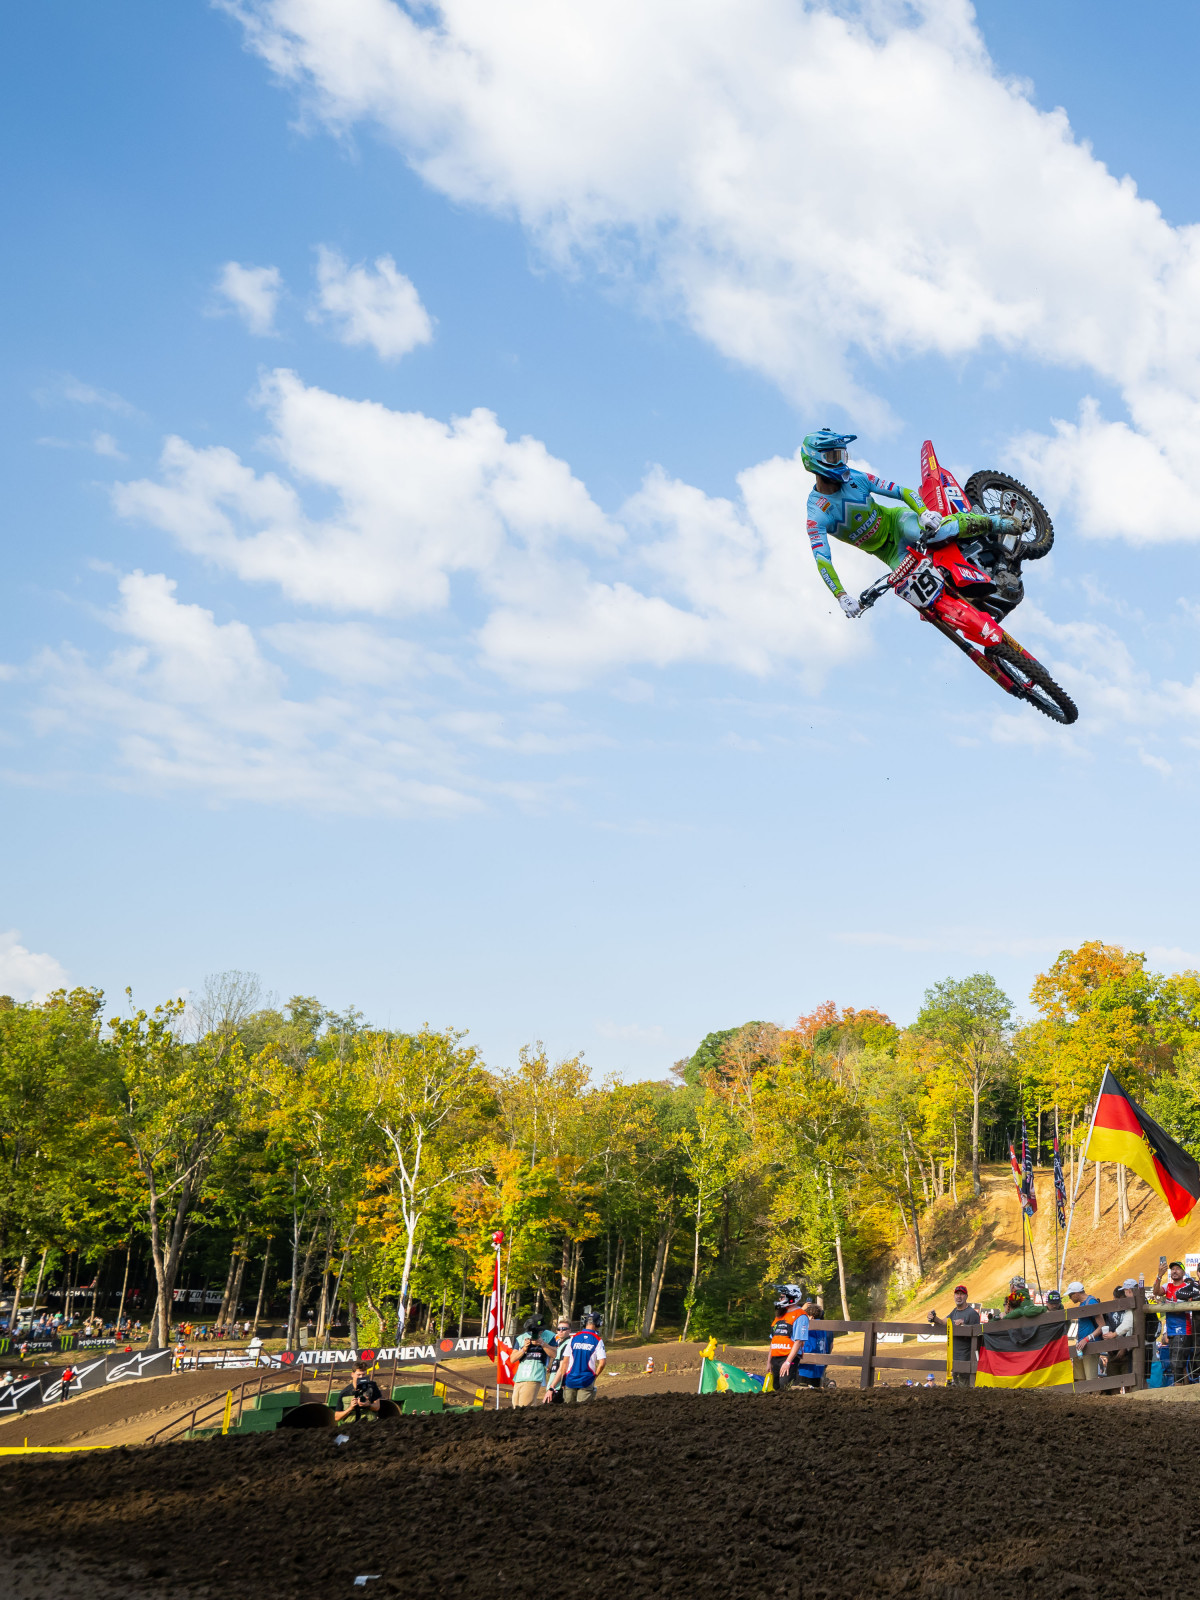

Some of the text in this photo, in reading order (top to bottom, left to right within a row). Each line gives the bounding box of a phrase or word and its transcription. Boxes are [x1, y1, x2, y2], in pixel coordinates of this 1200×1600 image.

[936, 485, 945, 510] HONDA
[849, 509, 877, 541] SLOVENIA
[855, 516, 882, 547] HONDA
[909, 569, 939, 604] 19
[14, 1341, 53, 1349] MNSTER
[78, 1338, 116, 1346] MONSTER
[455, 1336, 512, 1352] ATHA
[573, 1342, 595, 1351] FRANCE
[296, 1350, 358, 1365] ATHENA
[376, 1345, 437, 1362] ATHENA
